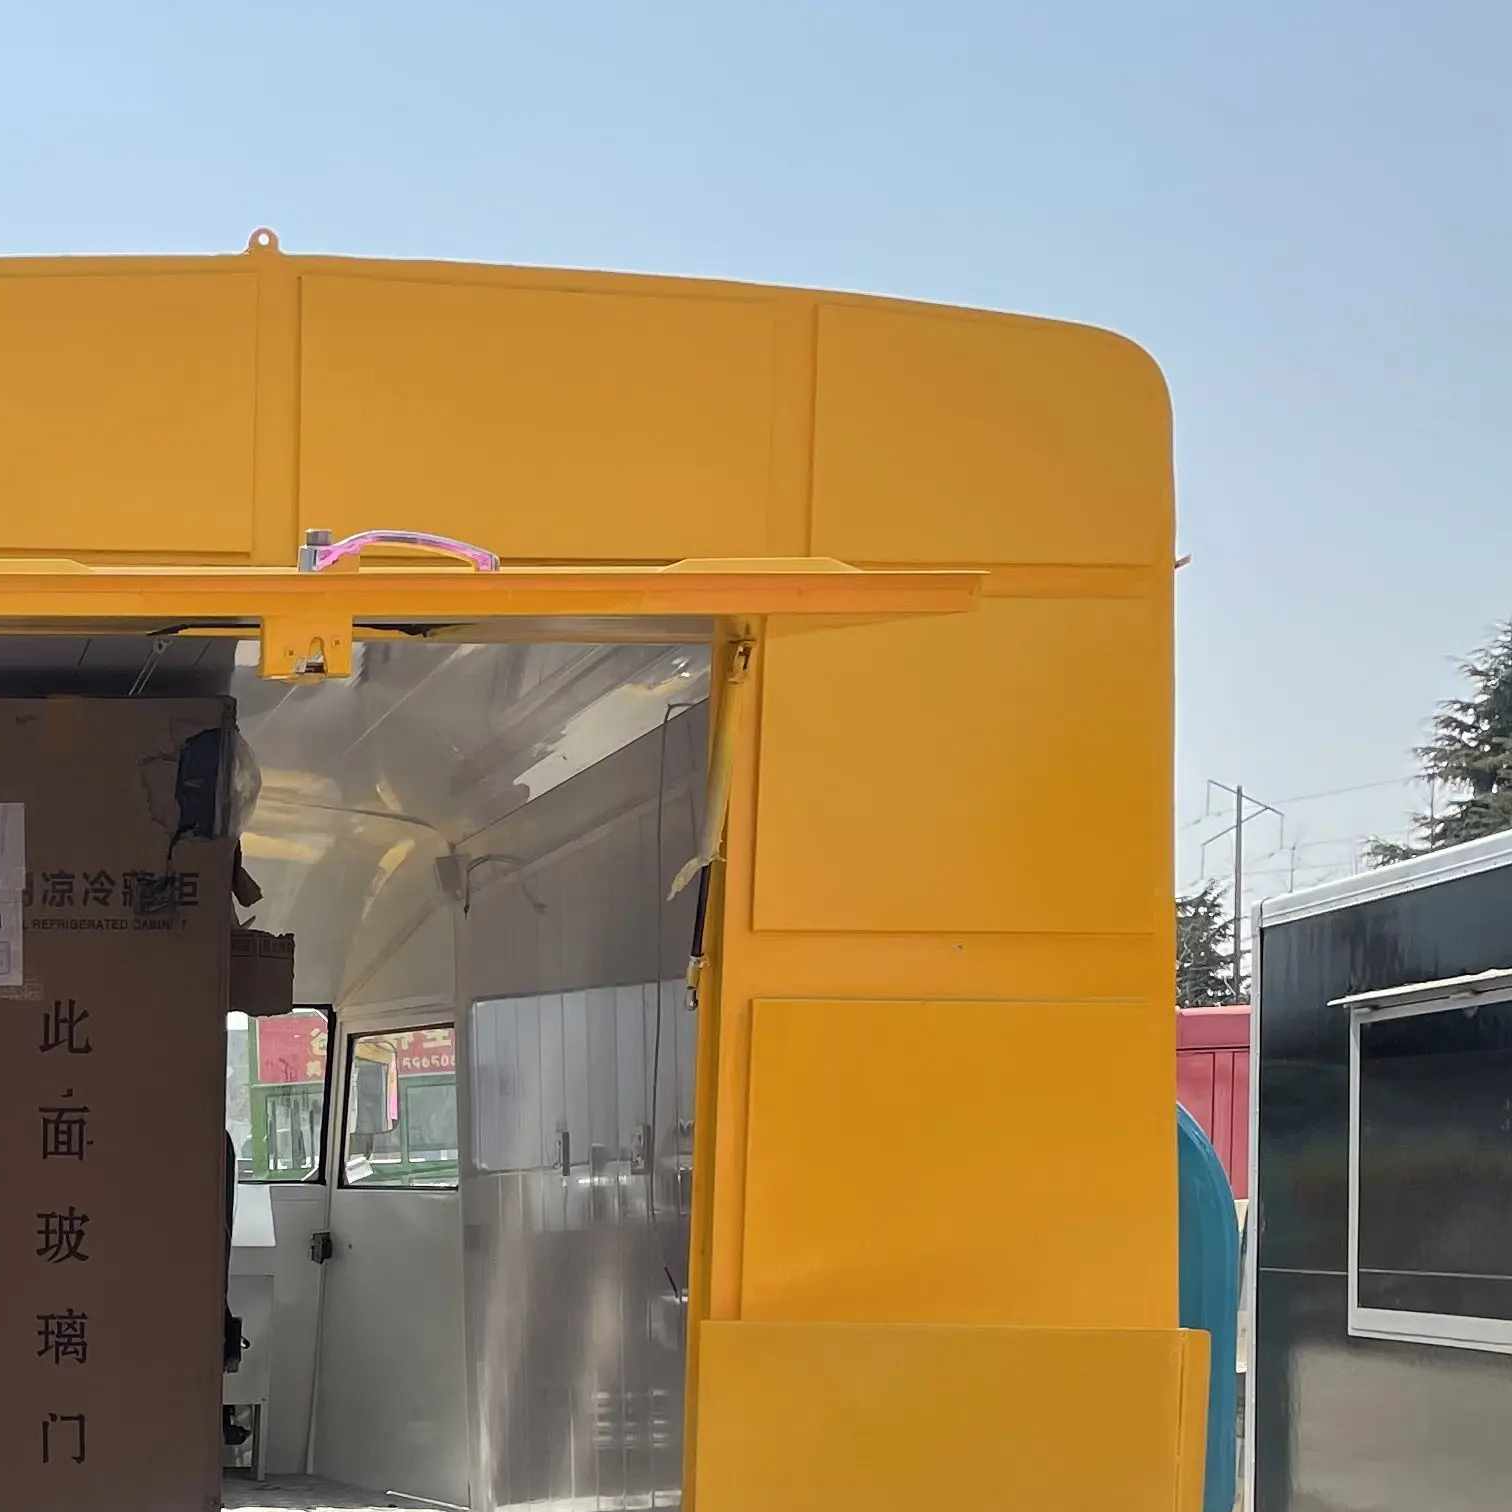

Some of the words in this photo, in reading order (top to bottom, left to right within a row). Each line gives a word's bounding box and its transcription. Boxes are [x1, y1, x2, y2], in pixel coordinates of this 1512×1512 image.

[33, 918, 129, 931] REFRIGERATED
[134, 918, 188, 931] CABINT
[36, 999, 93, 1465] 此面玻璃门
